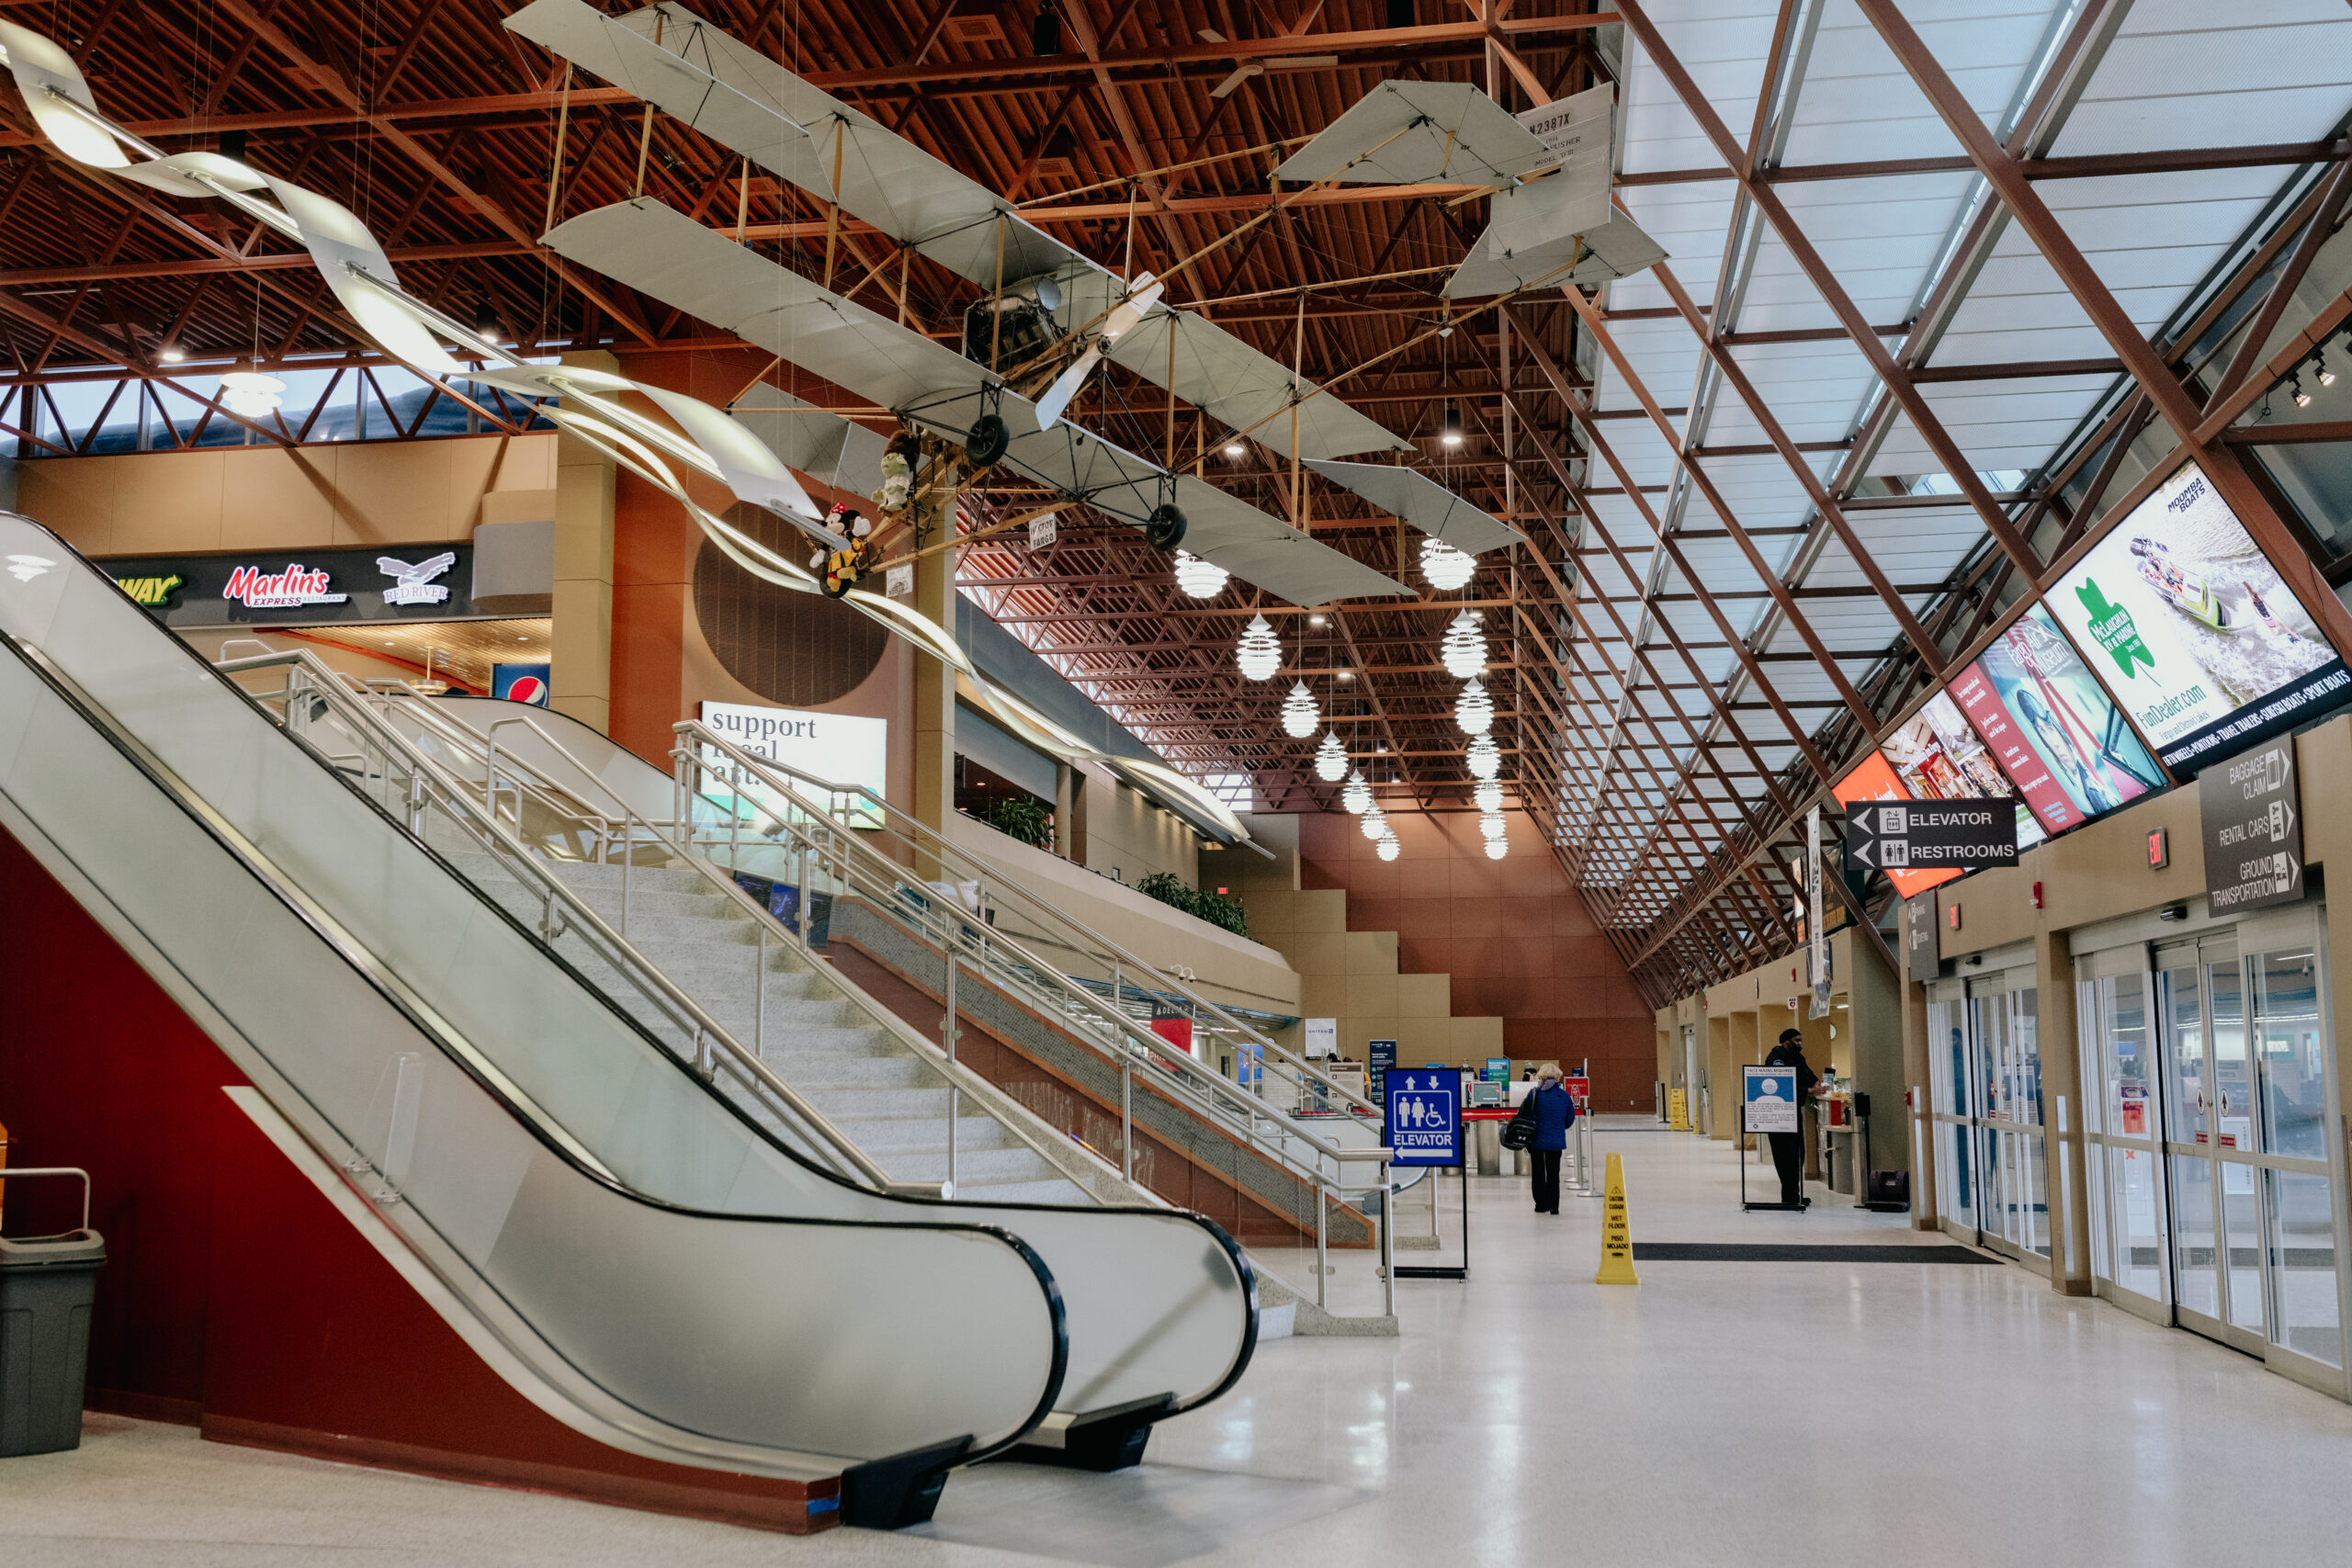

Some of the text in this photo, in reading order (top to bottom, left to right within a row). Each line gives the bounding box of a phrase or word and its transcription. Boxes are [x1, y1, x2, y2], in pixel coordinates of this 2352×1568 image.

[1529, 113, 1570, 135] N2387X
[1535, 155, 1557, 165] MODEL
[2168, 477, 2202, 513] MOOMBA
[2179, 484, 2206, 513] BOATS
[223, 563, 329, 606] Marlin's
[386, 586, 447, 602] RED RIVER
[253, 596, 301, 606] EXPRESS
[2135, 684, 2207, 729] FunDealer.com
[2218, 724, 2239, 741] TRAVEL
[2235, 713, 2262, 735] TRAILERS
[2281, 692, 2306, 713] BOATS
[2306, 681, 2328, 700] SPORT
[2324, 670, 2351, 691] BOATS
[712, 713, 817, 740] support
[2229, 754, 2266, 784] BAGGAGE
[2243, 776, 2267, 800] CLAIM
[1909, 812, 1993, 827] ELEVATOR
[2220, 815, 2269, 847] RENTAL CARS
[1911, 844, 2015, 859] RESTROOMS
[2240, 855, 2273, 881] GROUND
[2211, 877, 2276, 908] TRANSPORTATION
[1394, 1134, 1453, 1145] ELEVATOR
